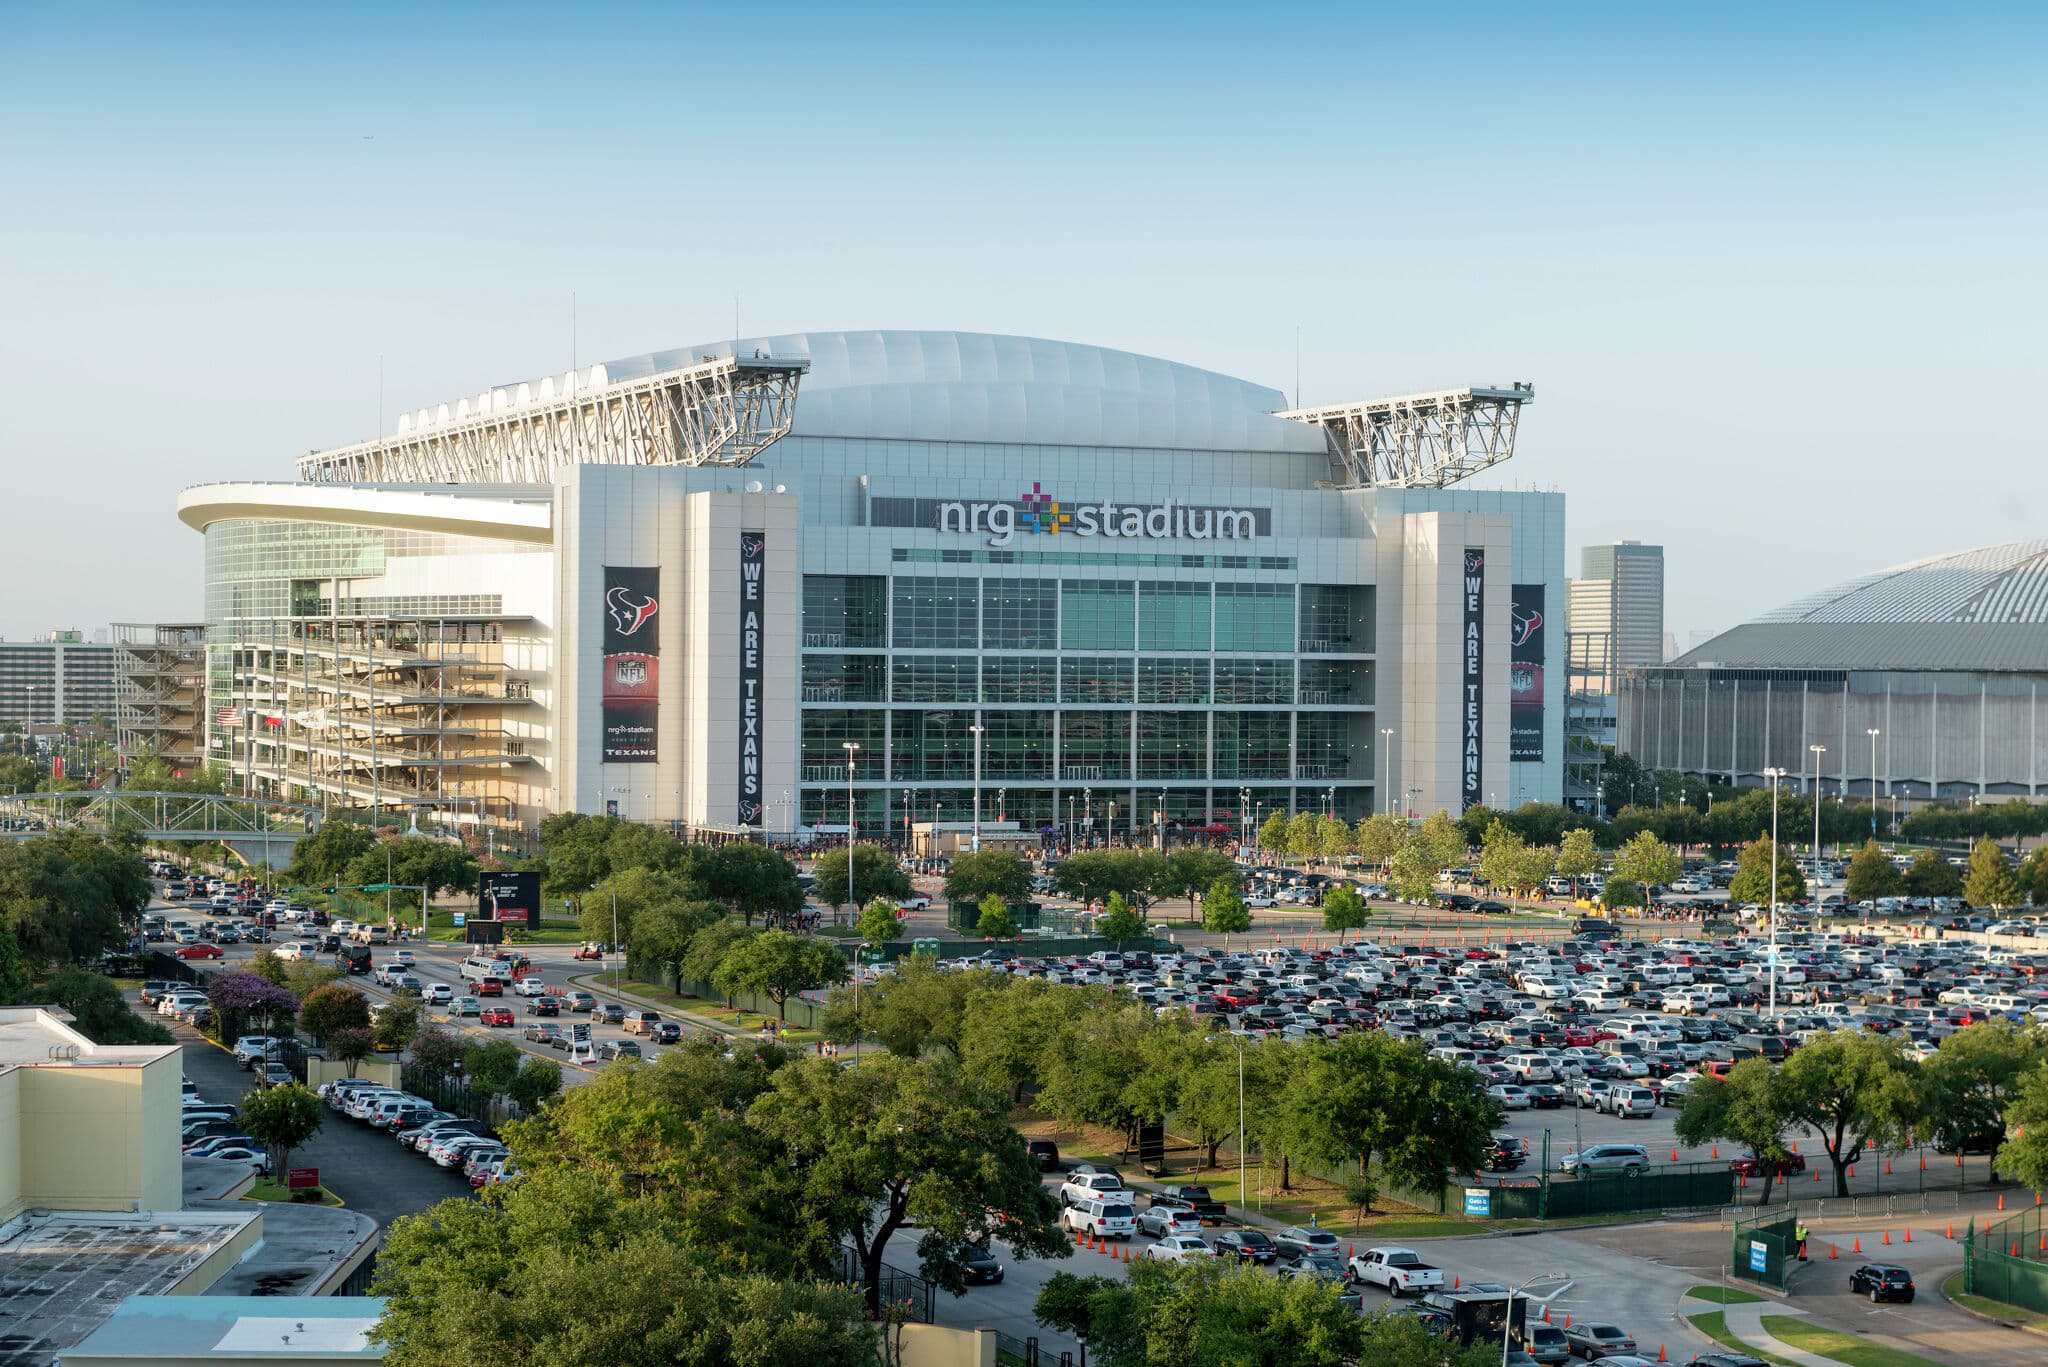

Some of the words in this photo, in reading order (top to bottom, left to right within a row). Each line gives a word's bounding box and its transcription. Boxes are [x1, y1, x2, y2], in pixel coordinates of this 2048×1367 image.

[940, 502, 1014, 547] nrg
[1076, 498, 1256, 540] stadium
[743, 563, 761, 600] WE
[1465, 577, 1481, 612] WE
[744, 611, 759, 668] ARE
[1467, 622, 1479, 675] ARE
[620, 668, 644, 682] NFL
[1512, 676, 1531, 688] NFL
[608, 727, 620, 735] nrg
[743, 679, 758, 794] TEXANS
[1466, 684, 1478, 791] TEXANS
